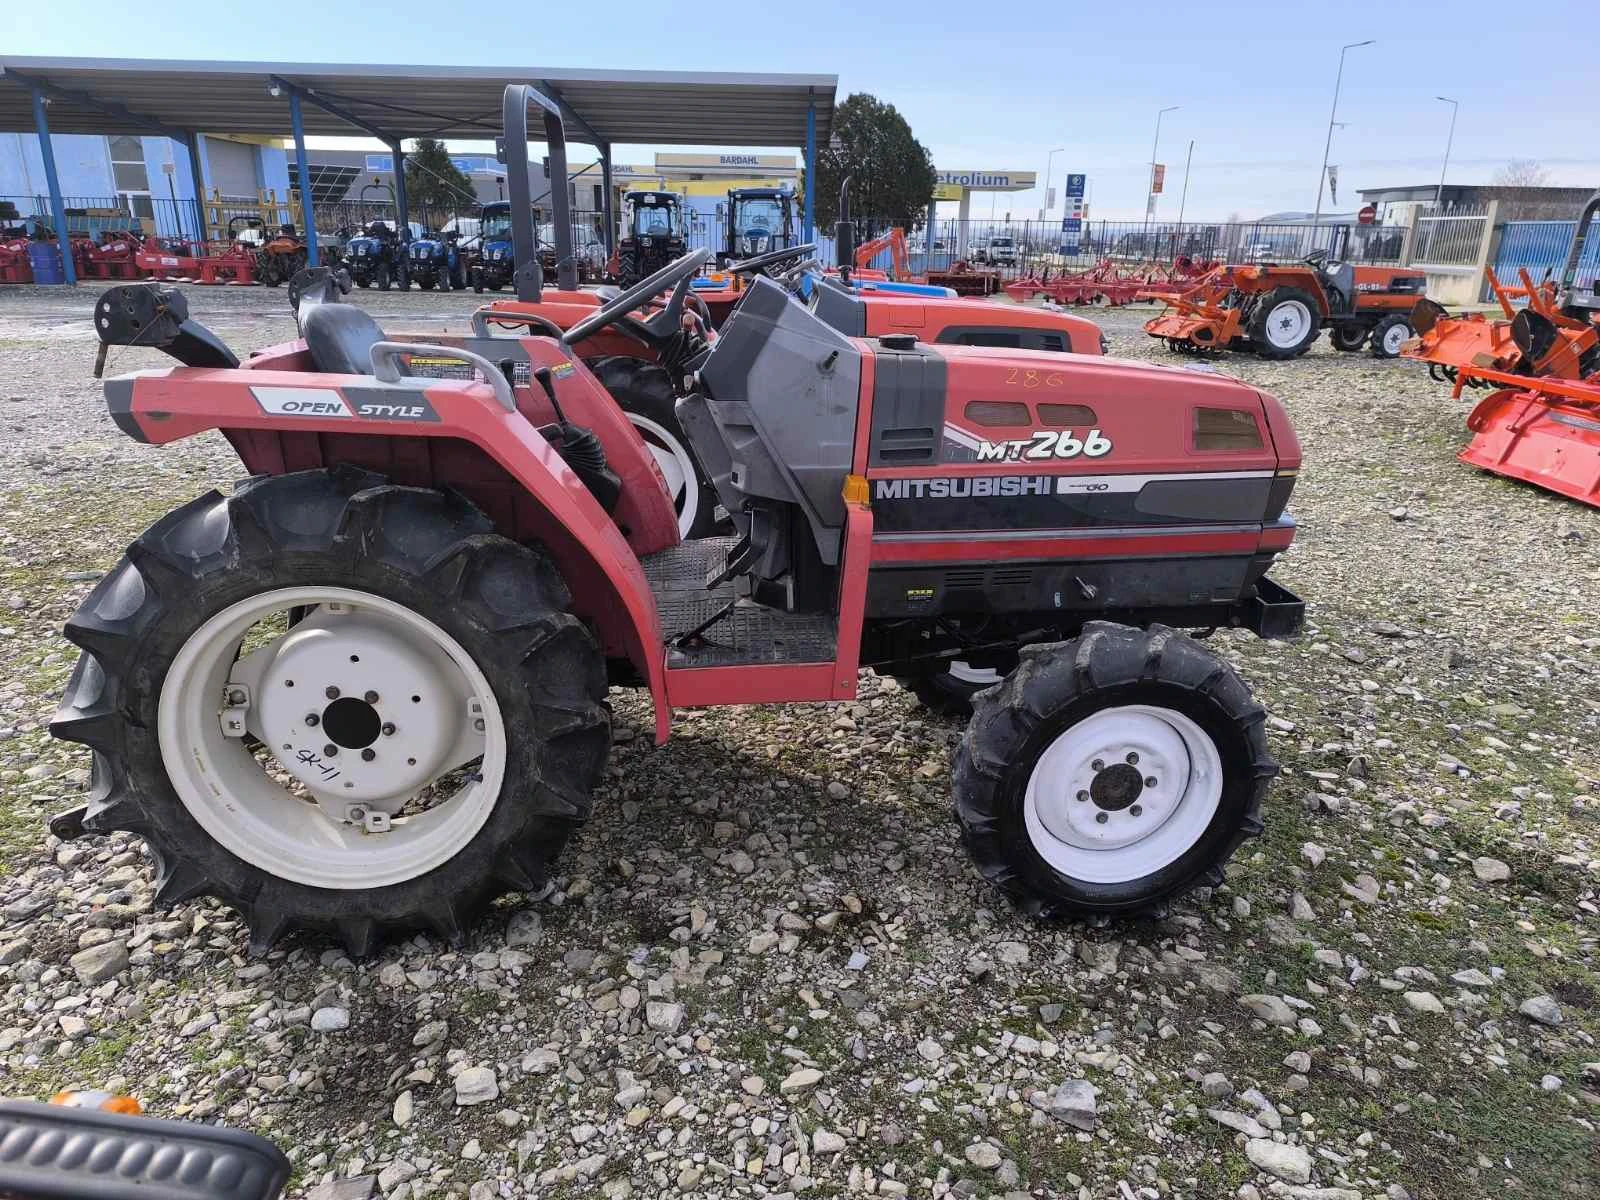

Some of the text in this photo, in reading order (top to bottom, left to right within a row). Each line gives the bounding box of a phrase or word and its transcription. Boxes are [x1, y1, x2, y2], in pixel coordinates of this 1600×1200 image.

[720, 155, 759, 165] BARDAHL
[935, 171, 1010, 186] etrolium
[281, 401, 425, 418] OPEN STYLE
[876, 475, 1051, 499] MITSUBISHI
